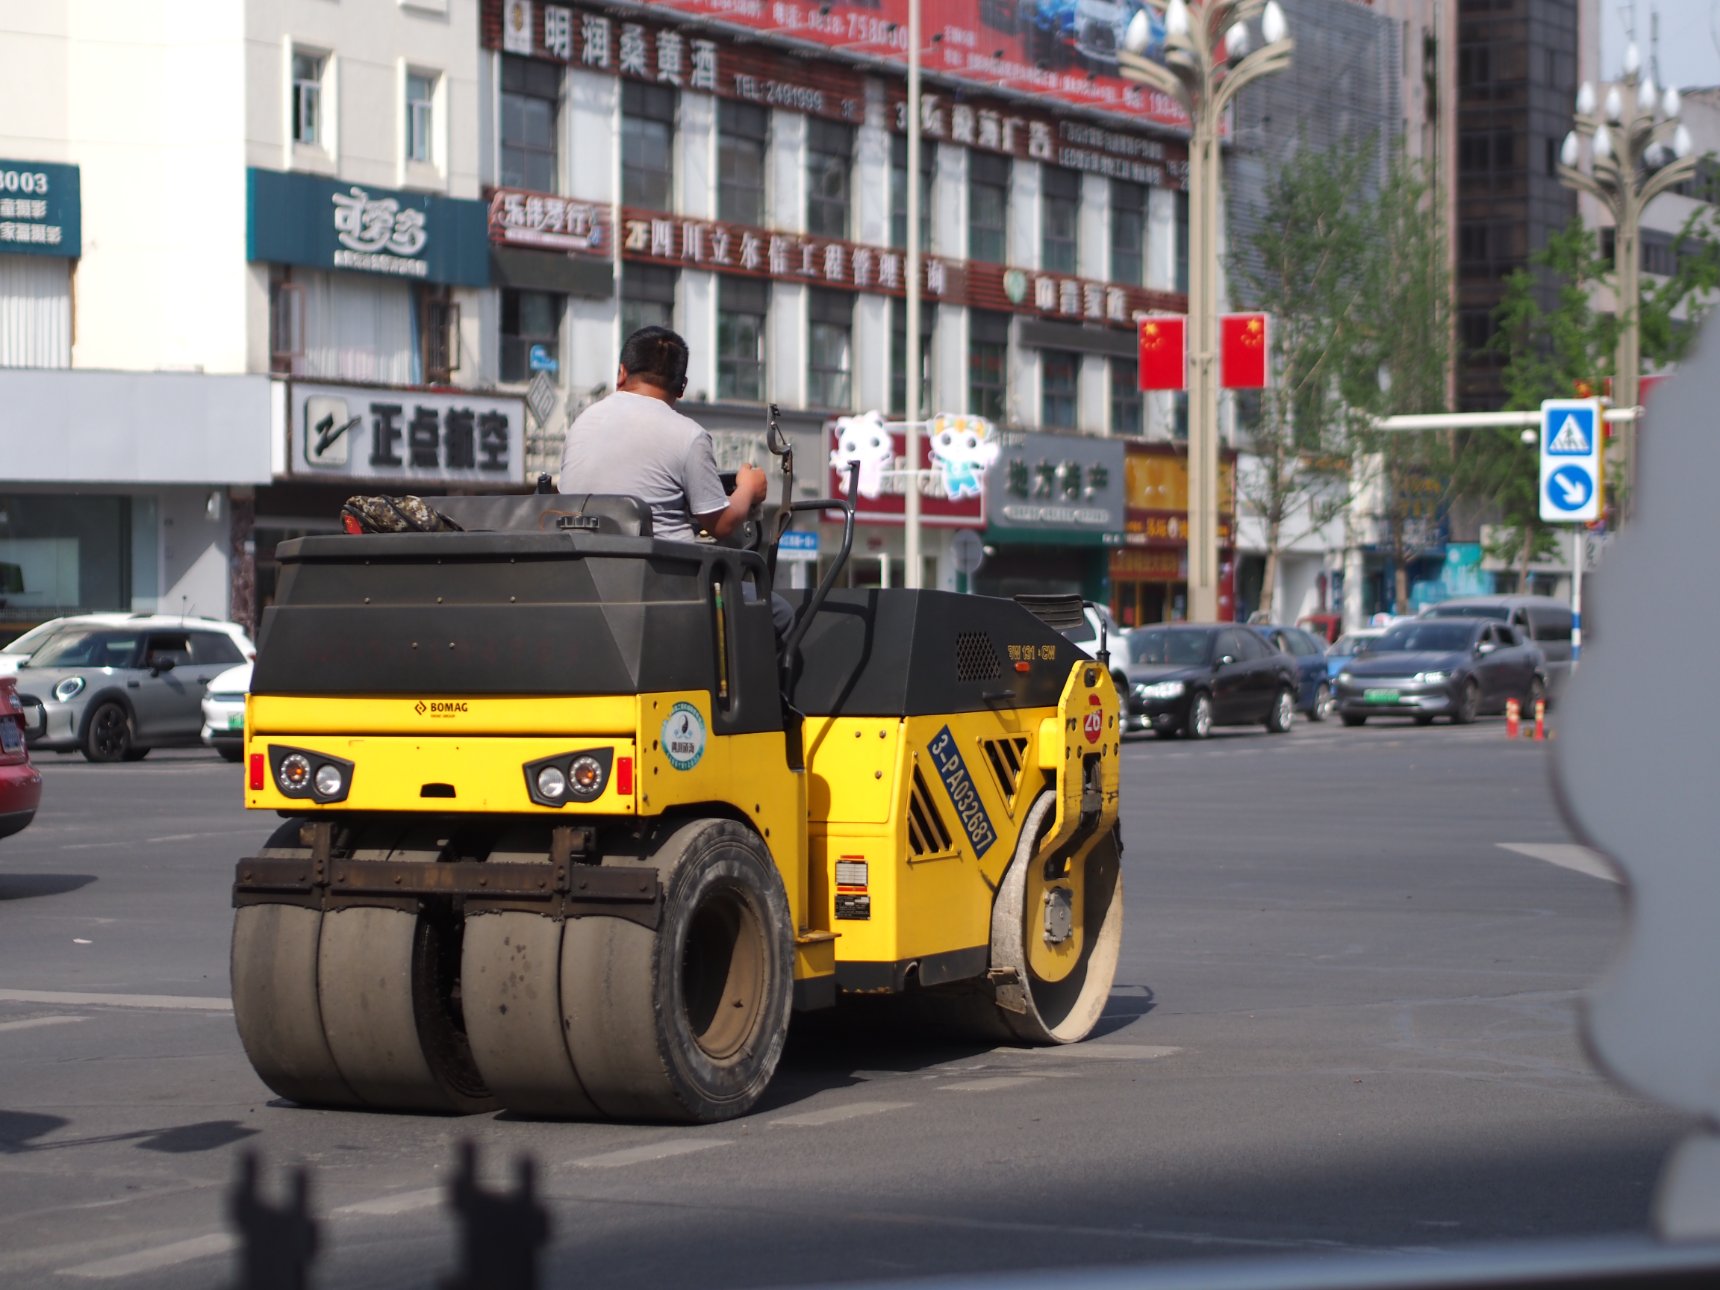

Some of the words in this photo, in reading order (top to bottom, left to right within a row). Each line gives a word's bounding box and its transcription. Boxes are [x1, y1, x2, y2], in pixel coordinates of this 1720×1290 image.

[544, 6, 718, 91] 明润桑黄酒
[369, 402, 509, 471] 正点航空
[430, 702, 468, 712] BOMAG
[932, 734, 993, 850] 3-PA032687
